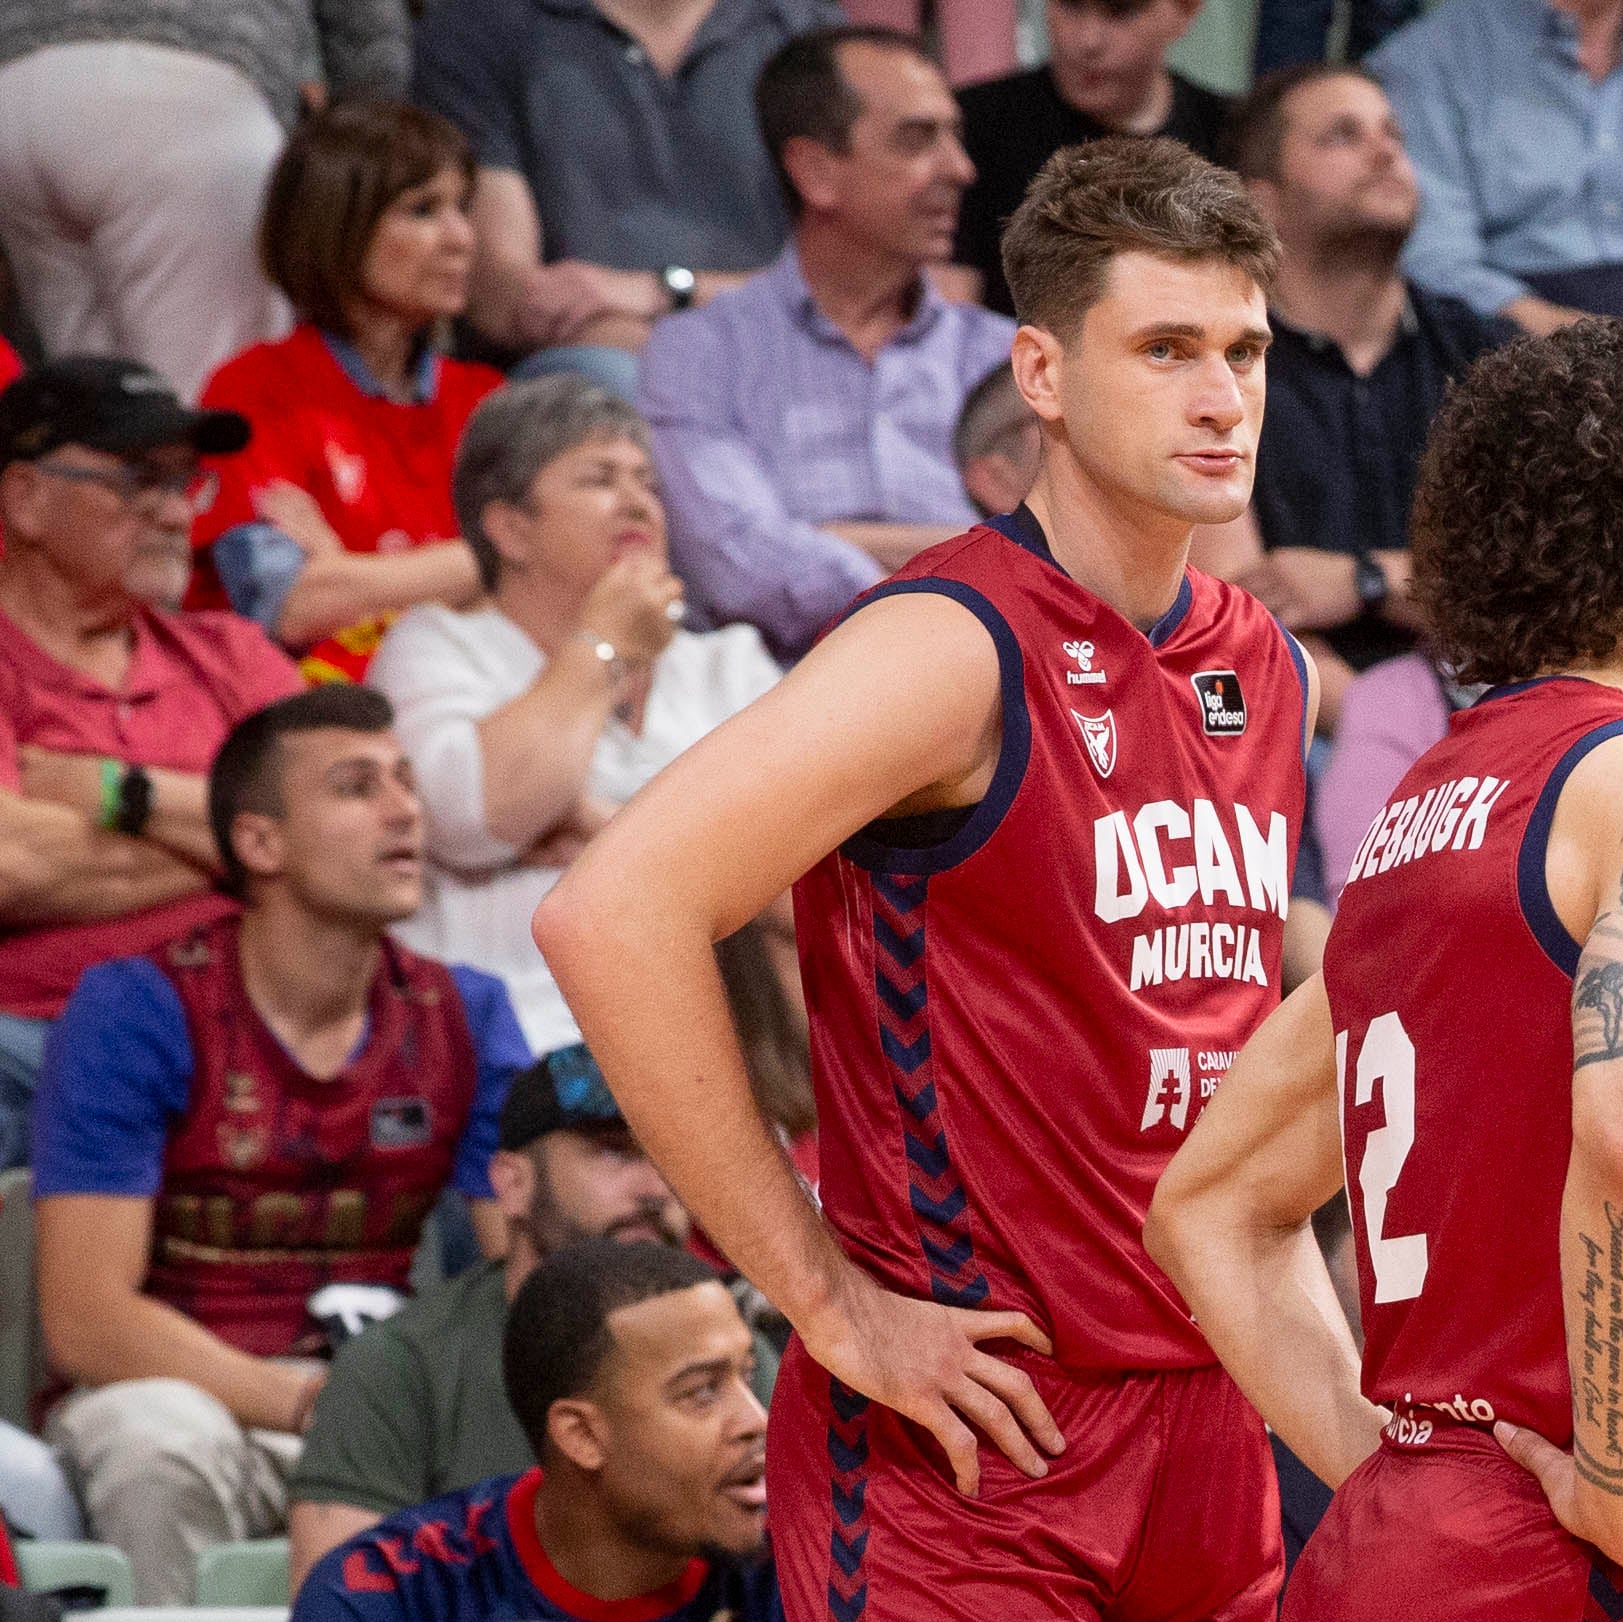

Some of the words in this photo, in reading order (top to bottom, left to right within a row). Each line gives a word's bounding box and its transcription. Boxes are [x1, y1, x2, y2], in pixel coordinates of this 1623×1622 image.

[1066, 670, 1107, 684] hummel
[1205, 691, 1223, 709] liga
[1208, 709, 1244, 726] endesa
[1094, 798, 1289, 924] UCAM
[1130, 922, 1269, 992] MURCIA
